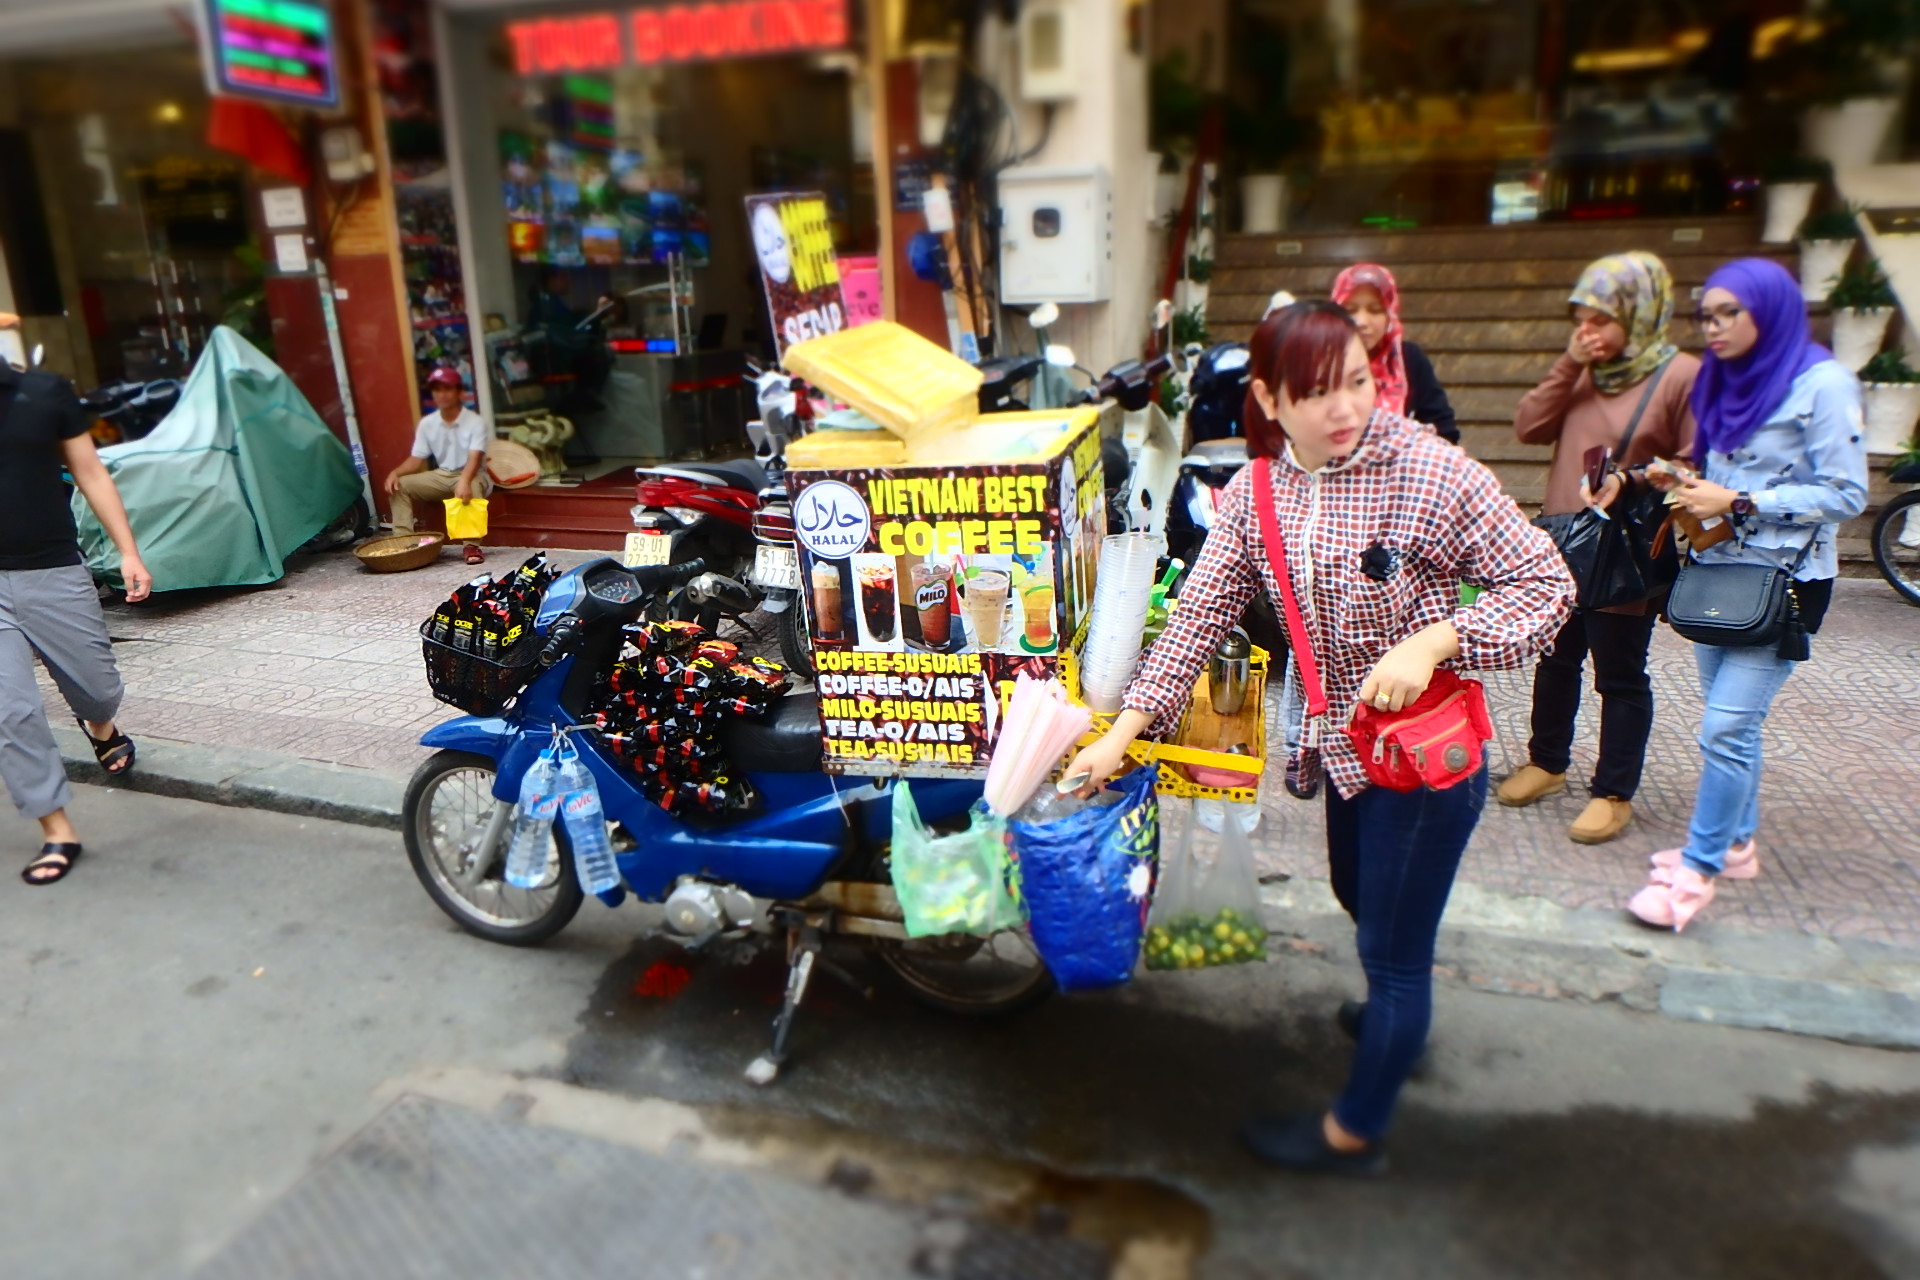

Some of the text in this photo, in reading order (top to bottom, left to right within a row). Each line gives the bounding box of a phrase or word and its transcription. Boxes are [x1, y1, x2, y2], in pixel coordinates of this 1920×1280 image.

[508, 0, 846, 72] TOUR BOOKING
[801, 495, 863, 531] حلال
[868, 477, 979, 515] VIETNAM
[984, 475, 1047, 513] BEST
[812, 534, 857, 545] HALAL
[879, 520, 1043, 556] COFFEE
[919, 589, 945, 604] MILO
